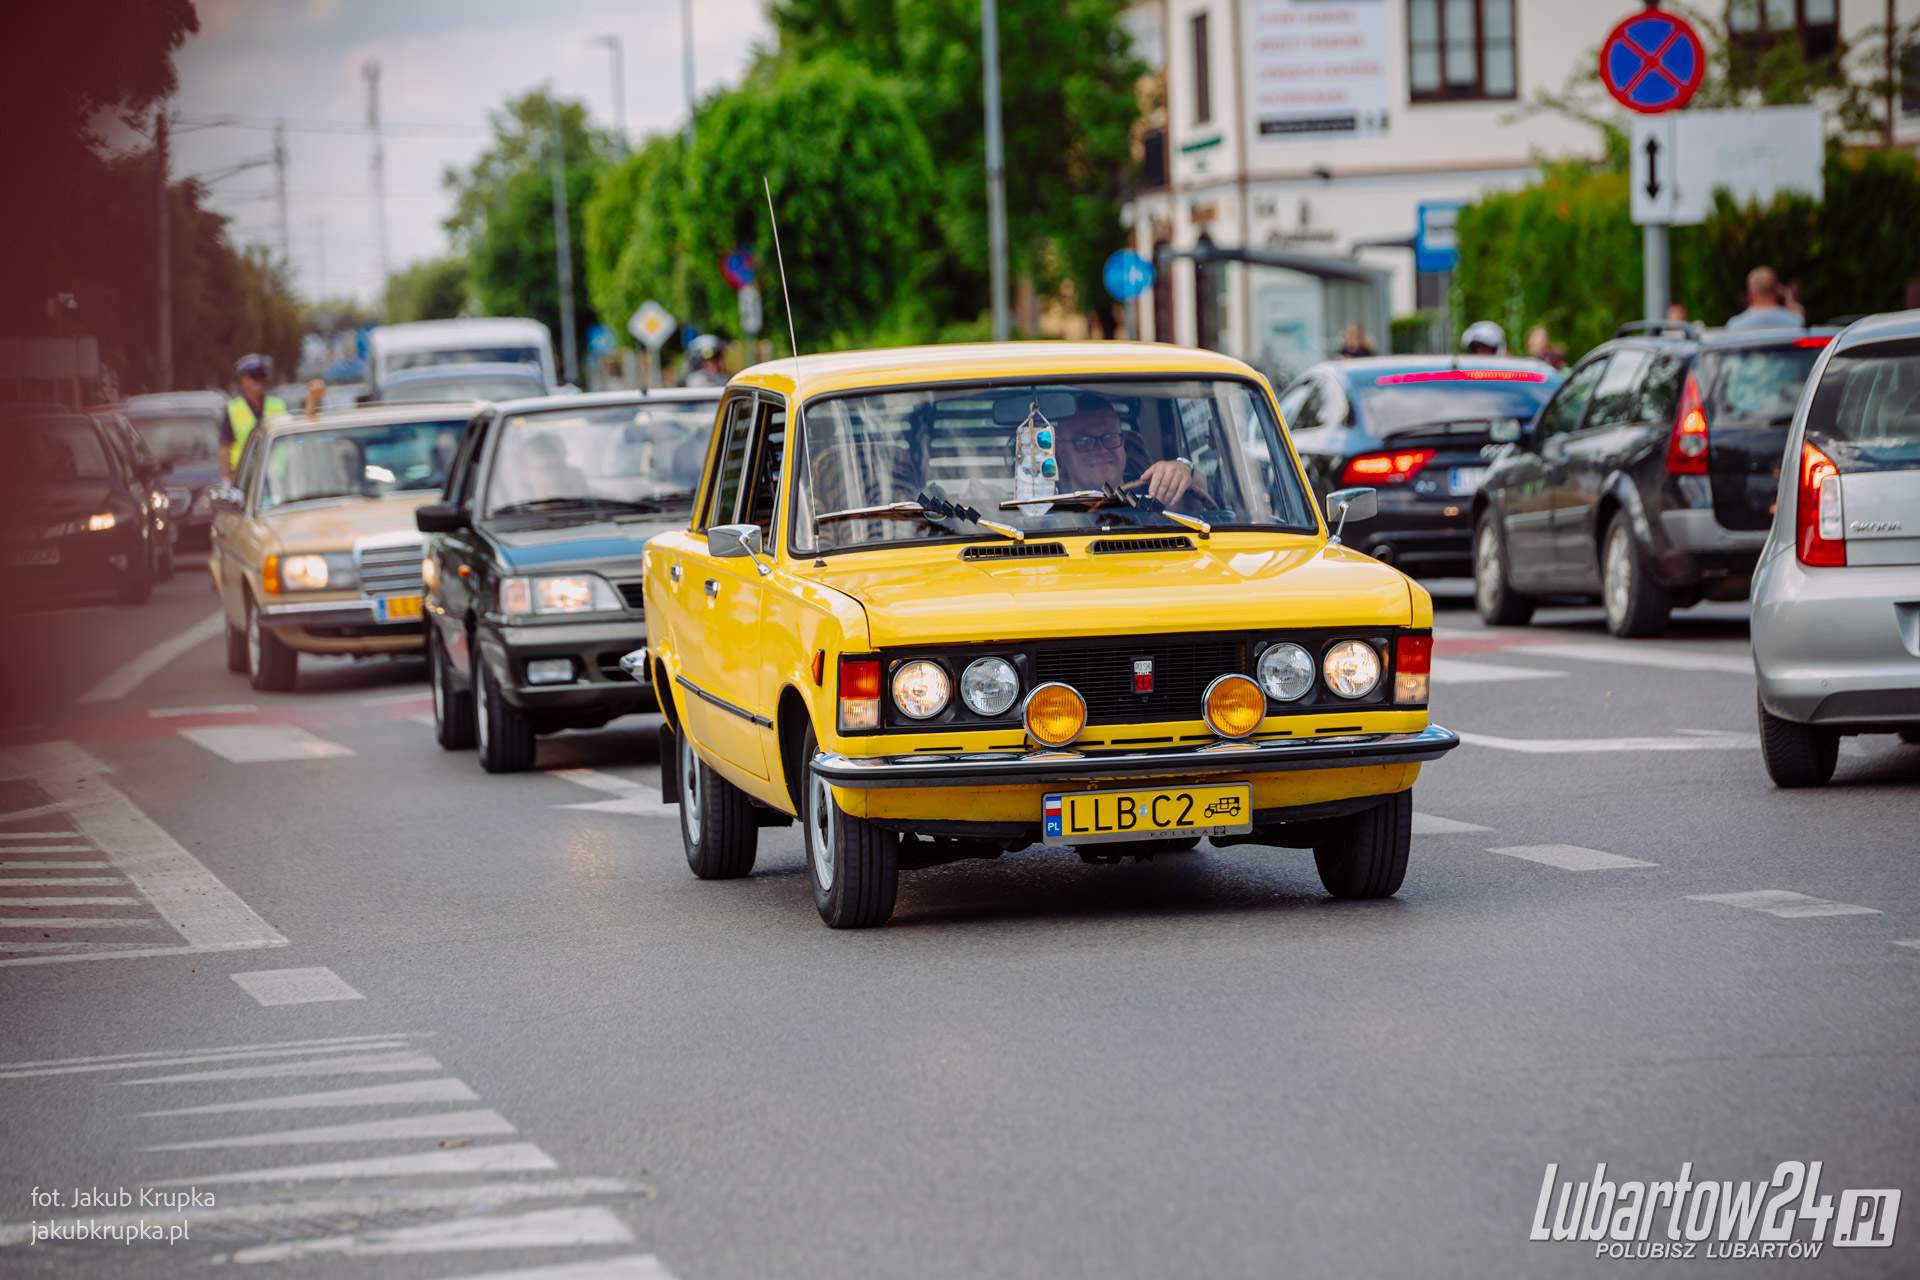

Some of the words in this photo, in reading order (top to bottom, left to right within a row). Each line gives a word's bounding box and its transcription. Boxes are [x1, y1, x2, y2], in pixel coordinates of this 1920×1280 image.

[1070, 797, 1137, 833] LLB
[1152, 793, 1195, 828] C2
[1047, 822, 1060, 832] PL
